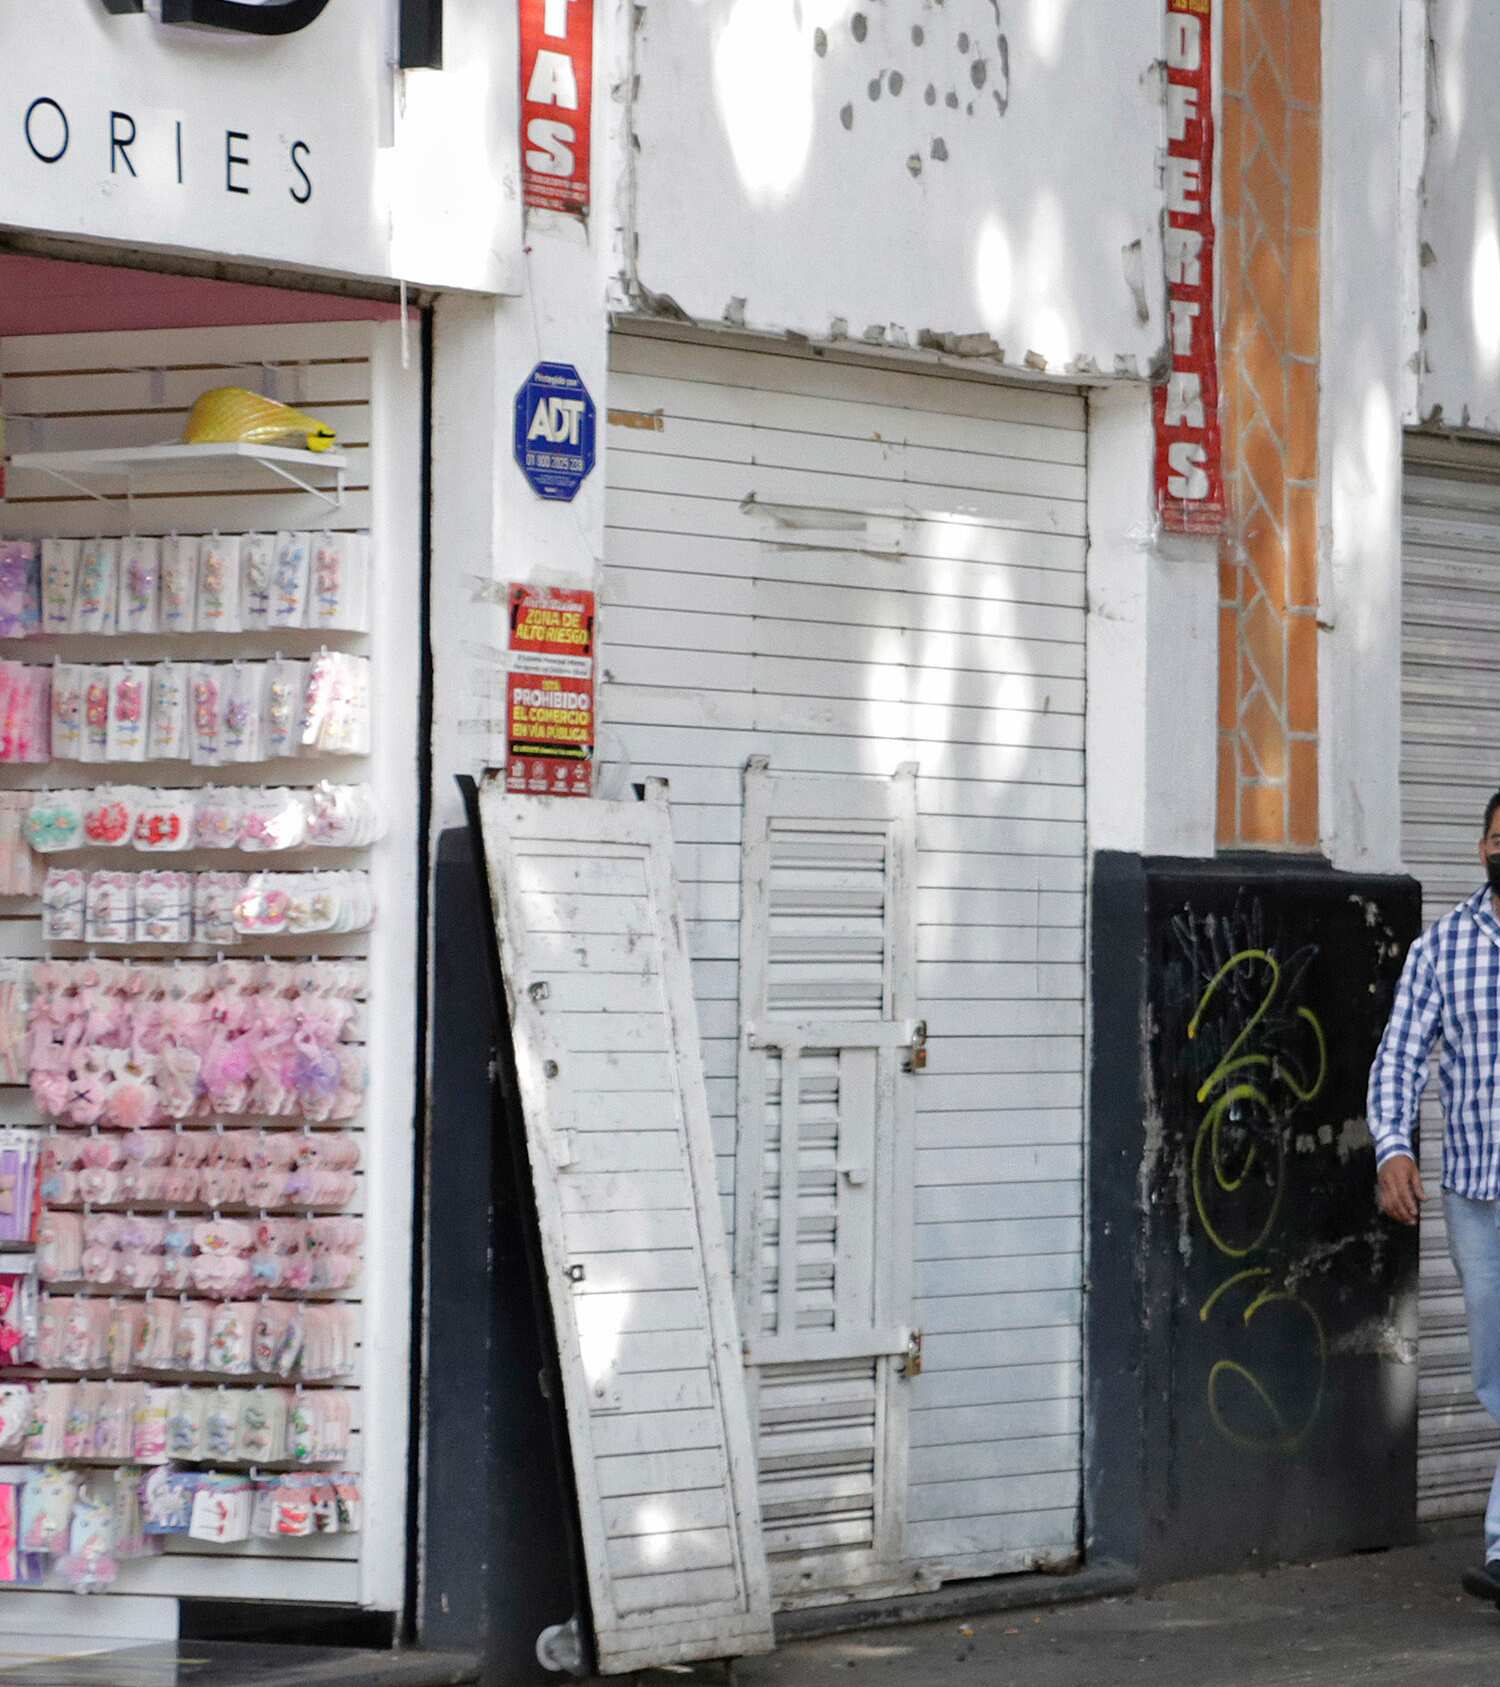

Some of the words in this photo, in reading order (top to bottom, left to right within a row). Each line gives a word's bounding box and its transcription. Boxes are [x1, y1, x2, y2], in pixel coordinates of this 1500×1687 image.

[25, 97, 313, 204] ORIES
[1164, 12, 1208, 500] OFERTAS
[527, 397, 585, 445] ADT
[525, 608, 560, 626] ZONA
[562, 612, 582, 628] DE
[515, 623, 545, 642] ALTO
[513, 688, 590, 711] PROHIBIDO
[513, 705, 528, 721] EL
[528, 707, 589, 726] COMERCIO
[512, 722, 528, 737] EN
